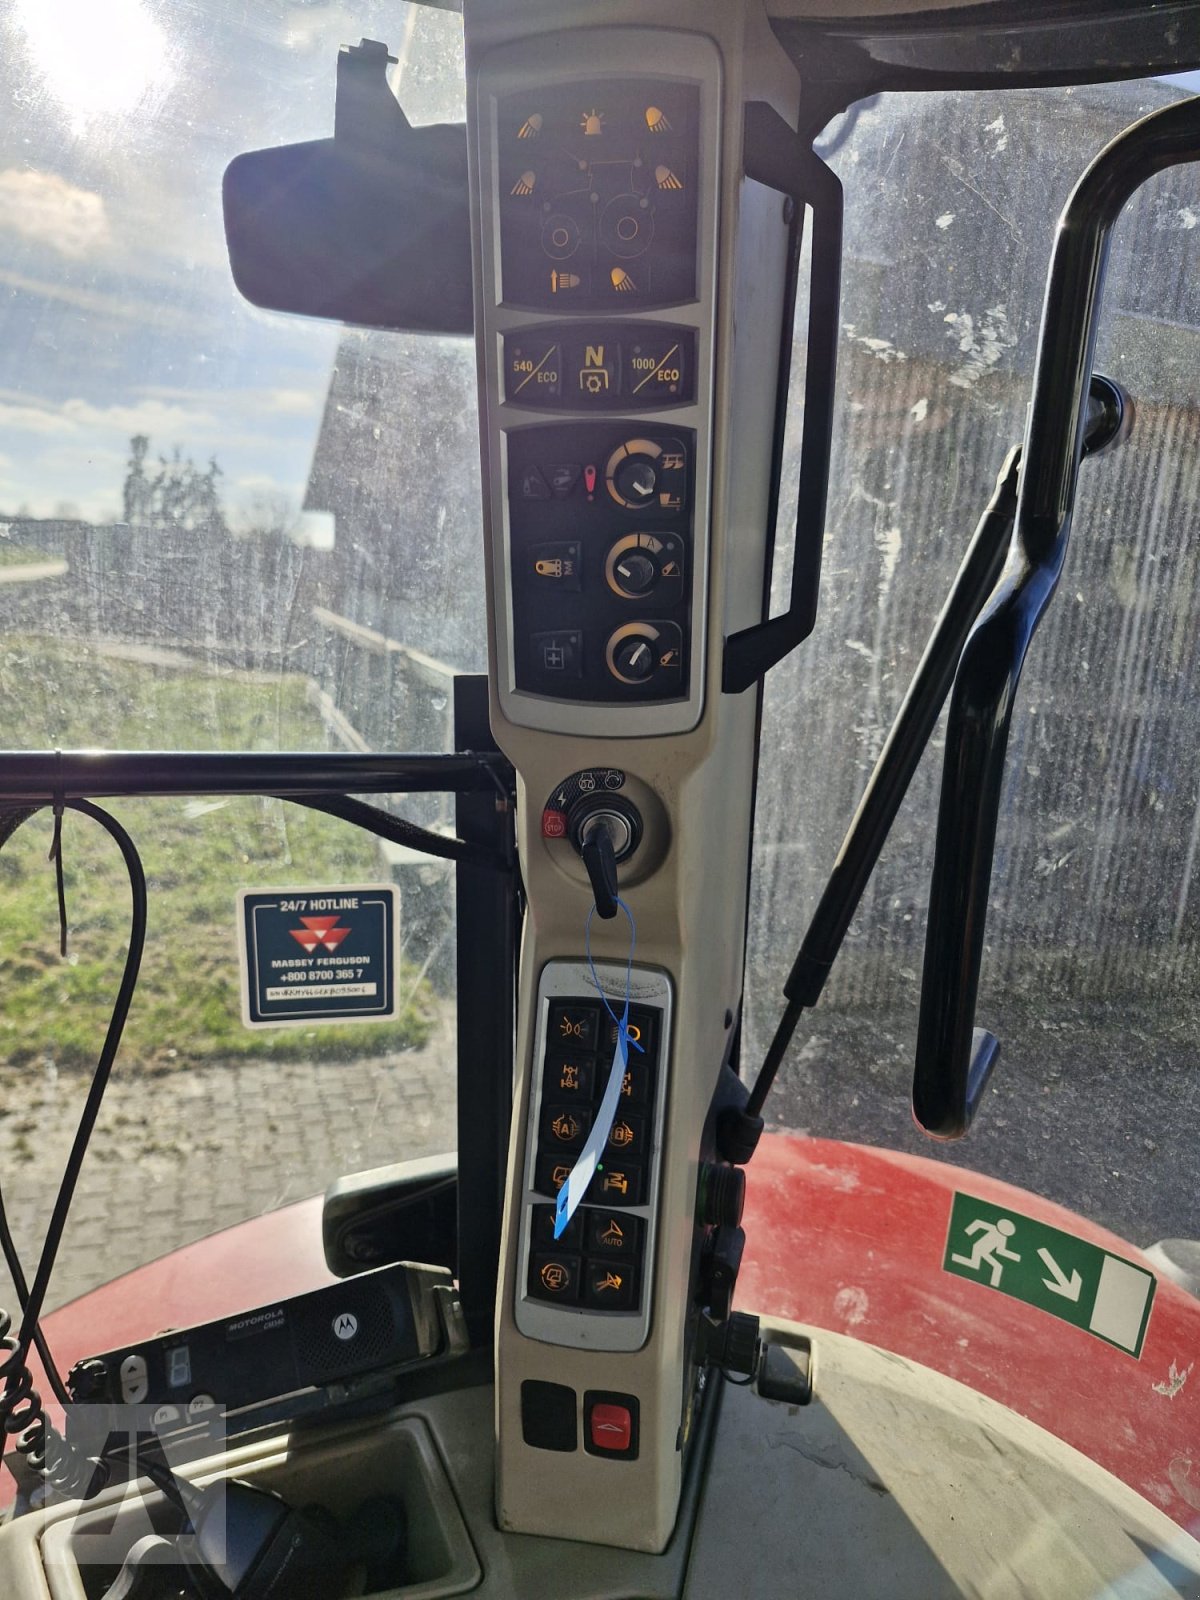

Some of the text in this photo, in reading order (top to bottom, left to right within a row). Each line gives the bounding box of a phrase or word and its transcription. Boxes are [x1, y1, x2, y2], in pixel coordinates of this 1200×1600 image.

[585, 345, 604, 367] N
[513, 360, 533, 372] 540
[632, 358, 655, 370] 1000
[537, 371, 558, 383] ECO
[657, 369, 680, 382] ECO
[548, 824, 562, 832] STOP
[280, 898, 359, 912] 24/7 HOTLINE
[271, 956, 370, 968] MASSEY FERGUSON
[280, 968, 364, 982] +800 8700 365 7
[602, 1237, 623, 1247] AUTO
[228, 1308, 284, 1333] MOTOROLA
